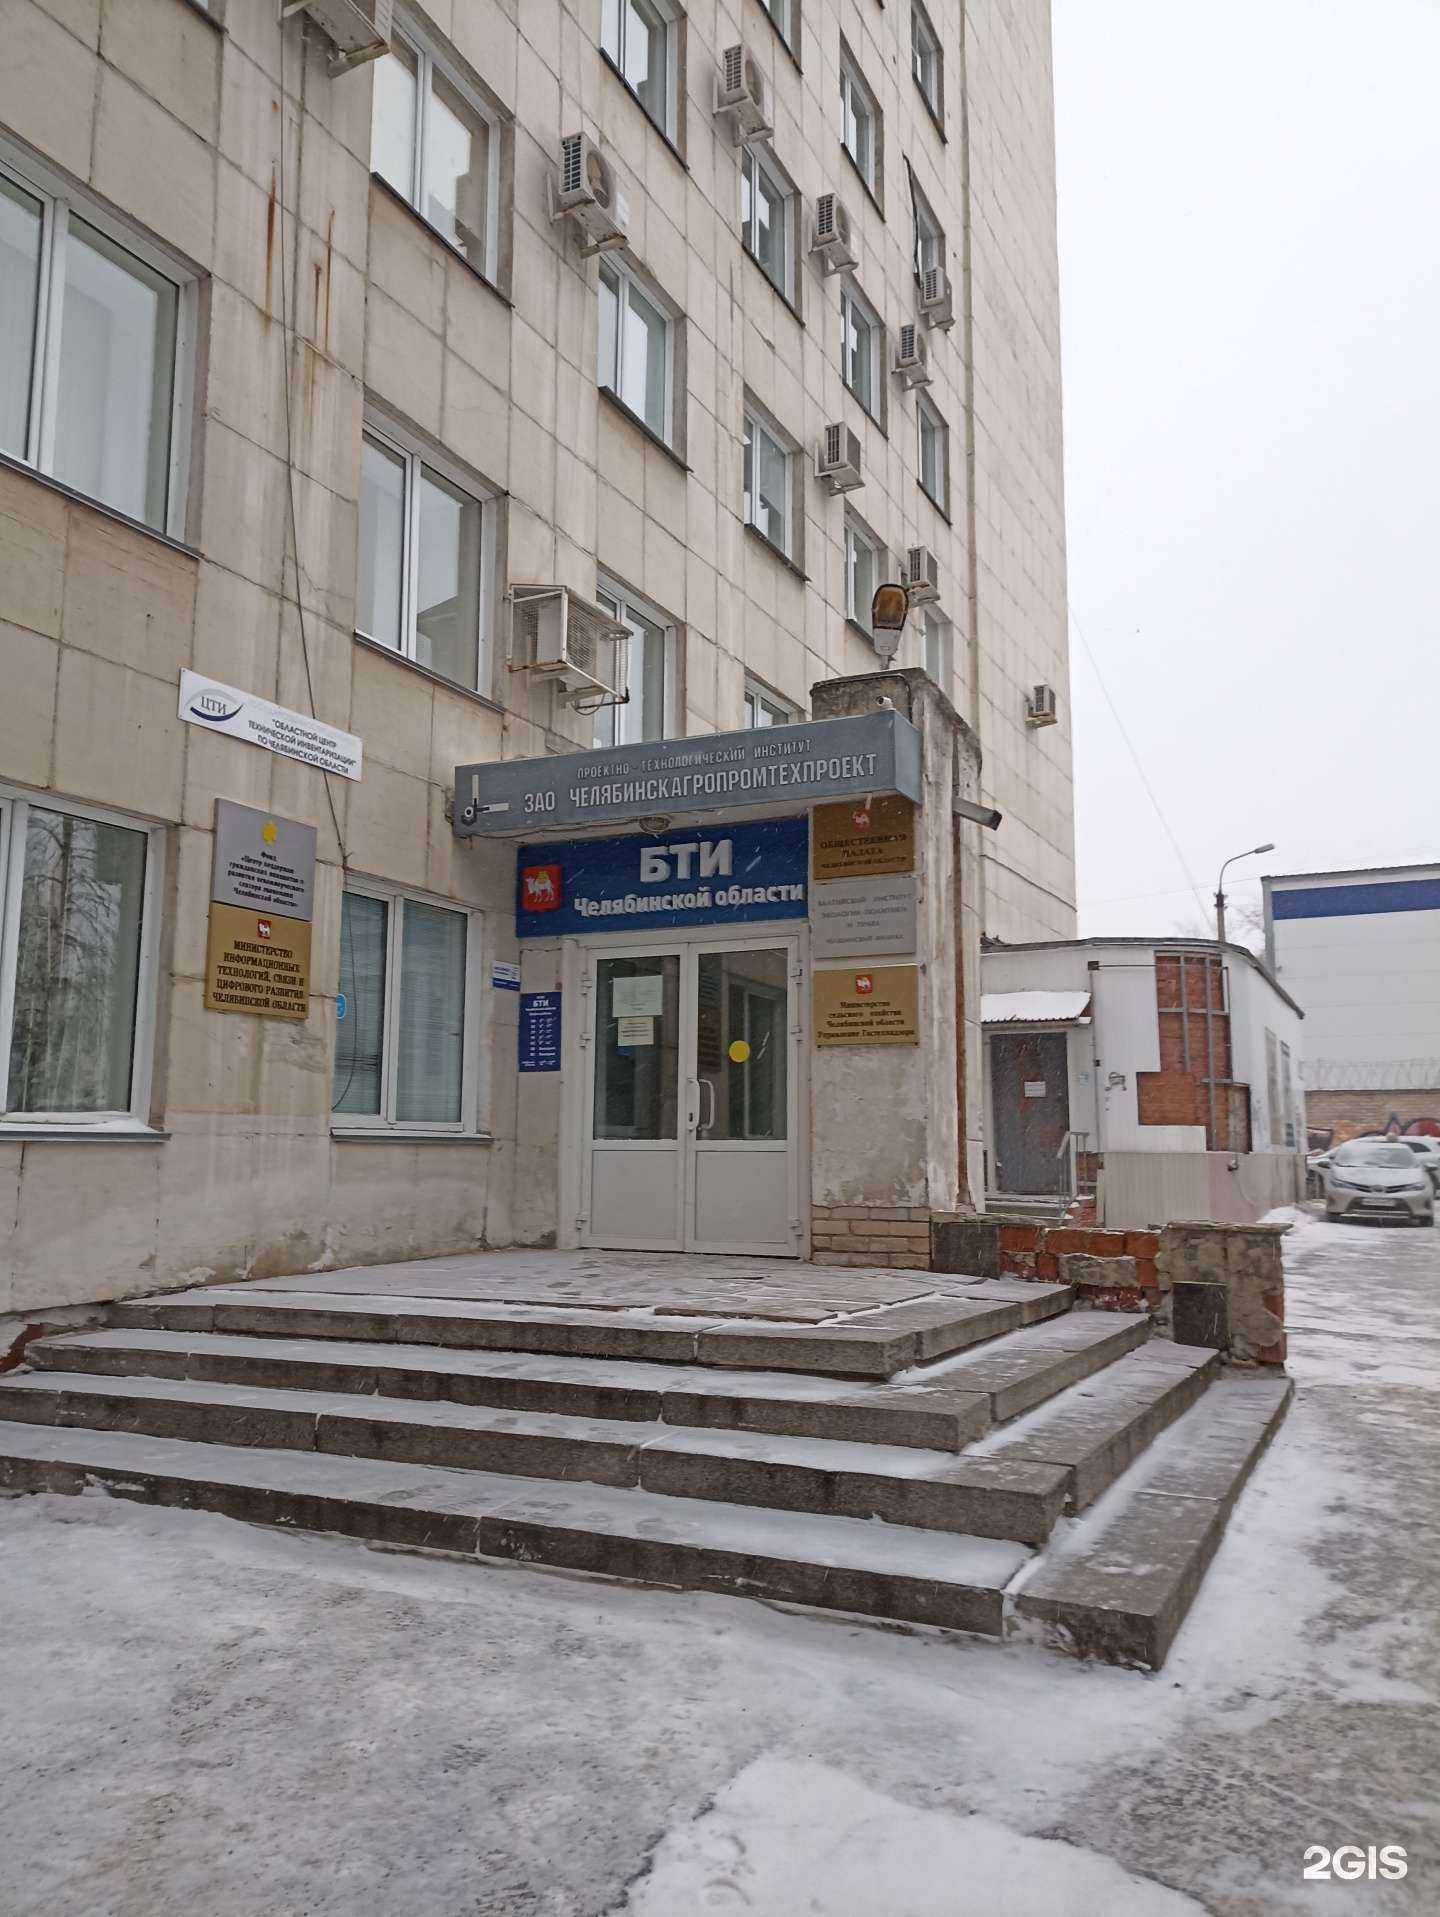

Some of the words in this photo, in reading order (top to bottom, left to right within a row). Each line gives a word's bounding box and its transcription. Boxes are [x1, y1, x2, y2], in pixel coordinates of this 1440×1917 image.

[200, 696, 227, 715] ЦТИ
[248, 720, 297, 744] ТЕХНИЧЕСКОЙ
[319, 736, 337, 748] ЦЕНТР
[257, 735, 268, 745] ПО
[268, 739, 319, 764] ЧЕЛЯБИНСКОЙ
[319, 757, 349, 774] ОБЛАСТИ
[577, 763, 630, 779] ПРОЕКТНО
[641, 745, 746, 772] ТЕХНОЛОГИЧЕСКИЙ
[754, 739, 812, 758] ИНСТИТУТ
[524, 791, 556, 813] ЗАО
[569, 753, 877, 808] ЧЕЛЯБИНСКАГРОПРОМТЕХПРОЕКТ
[639, 839, 733, 883] БТИ
[573, 886, 711, 917] Челябинской
[715, 884, 804, 906] области
[233, 940, 294, 958] МИНИСТЕРСТВО
[223, 952, 300, 973] ИНФОРМАЦИОННЫХ
[217, 965, 271, 982] ТЕХНОЛОГИЙ,
[273, 973, 297, 986] СВЯЗИ
[298, 977, 305, 987] И
[216, 979, 264, 994] ЦИФРОВОГО
[265, 986, 304, 999] РАЗВИТИЯ
[212, 992, 270, 1008] ЧЕЛЯБИНСКОЙ
[272, 999, 306, 1012] ОБЛАСТИ
